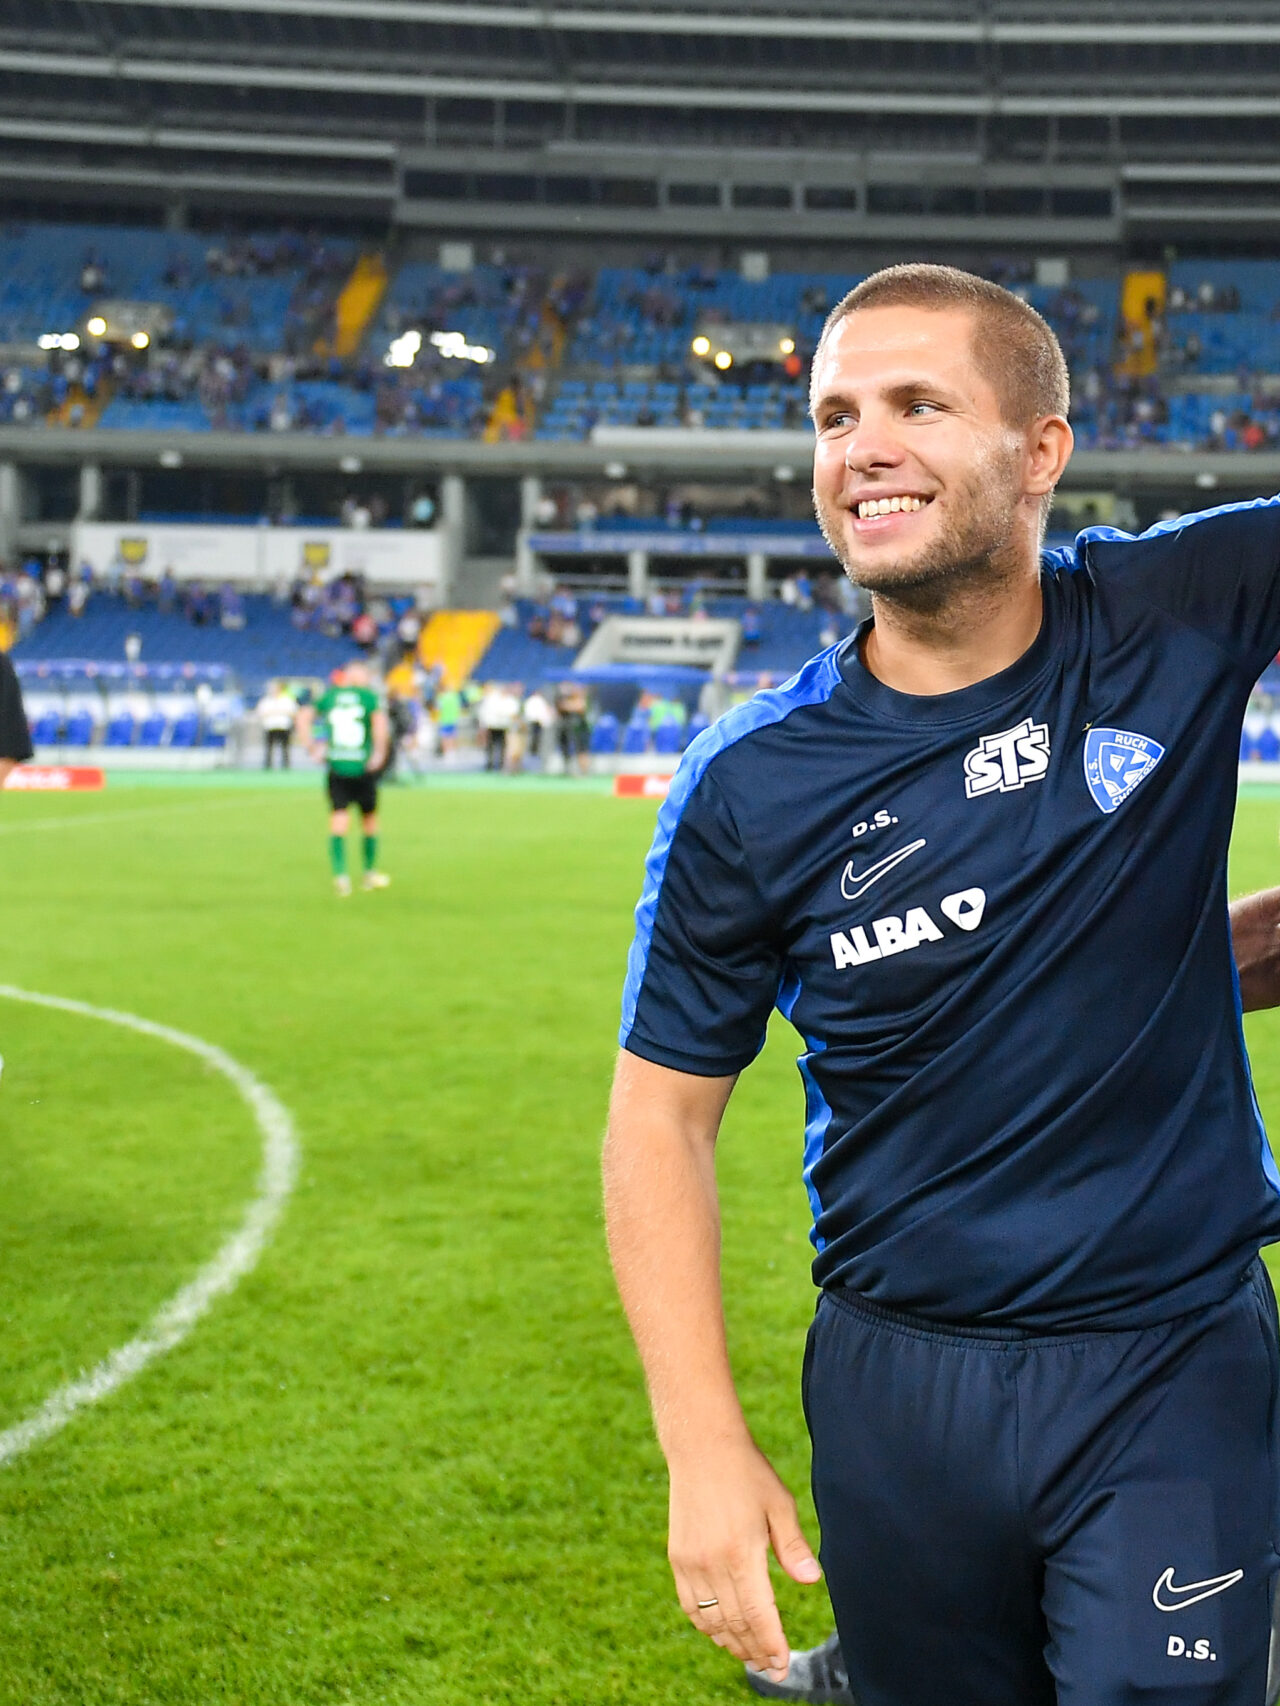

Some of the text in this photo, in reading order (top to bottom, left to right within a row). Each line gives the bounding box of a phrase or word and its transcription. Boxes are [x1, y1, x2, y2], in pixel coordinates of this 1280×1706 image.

[1114, 733, 1148, 751] RUCH
[963, 716, 1052, 800] STS
[852, 809, 899, 838] D.S.
[829, 906, 945, 970] ALBA
[1166, 1635, 1217, 1661] D.S.
